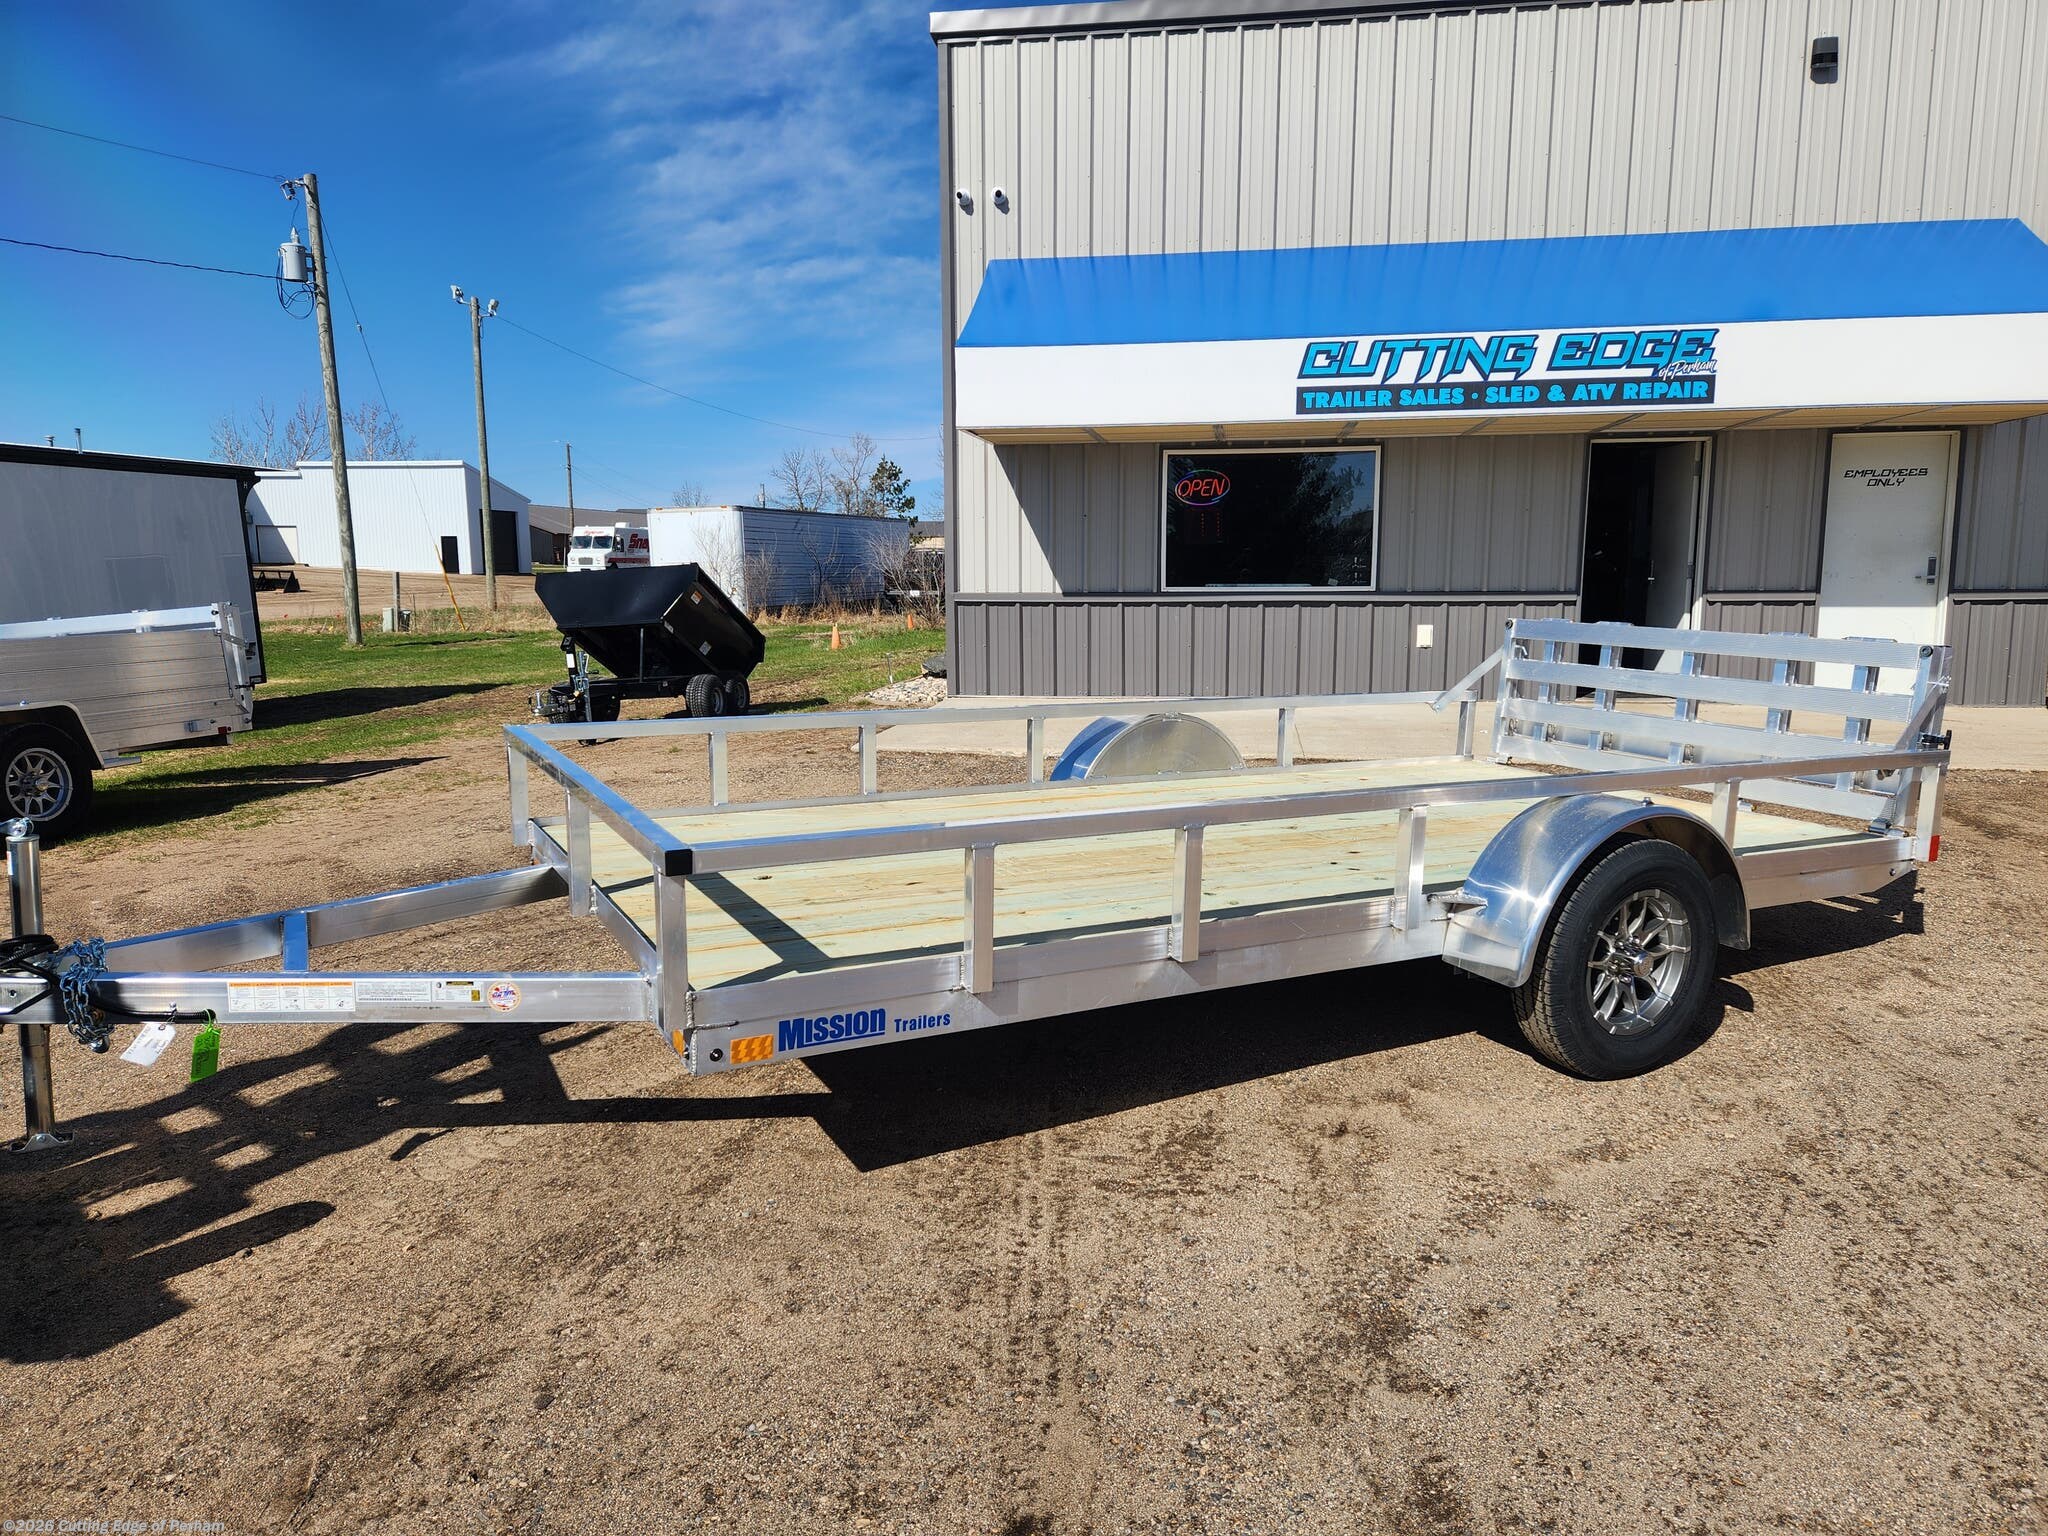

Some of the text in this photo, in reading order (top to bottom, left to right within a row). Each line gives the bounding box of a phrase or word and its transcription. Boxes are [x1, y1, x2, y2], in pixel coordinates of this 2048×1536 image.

[1297, 328, 1720, 384] CUTTING EDGE
[1669, 359, 1717, 380] Perham
[1303, 380, 1709, 409] TRAILER SALES SLED & ATV REPAIR
[1844, 467, 1928, 478] EMPLOYEES
[1178, 479, 1226, 497] OPEN
[1867, 478, 1905, 487] ONLY
[894, 1014, 951, 1033] Trailers
